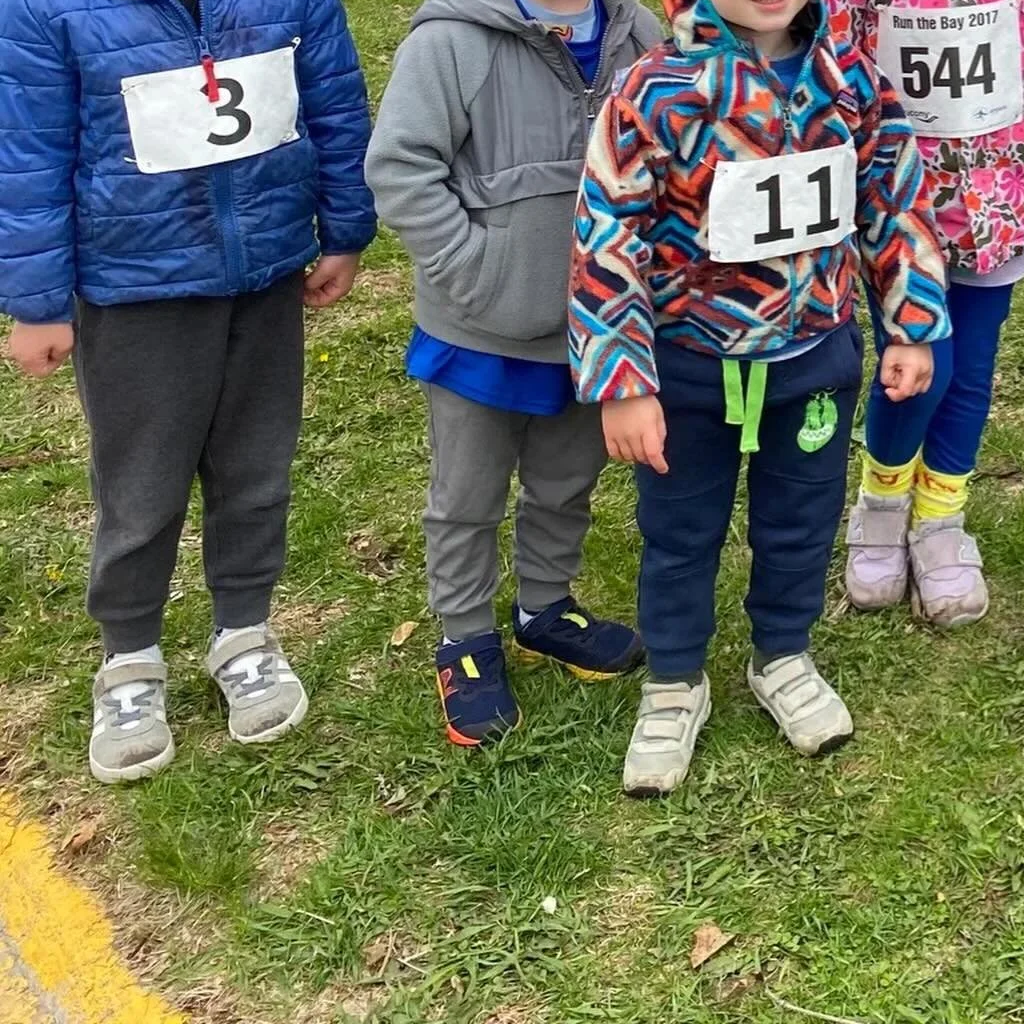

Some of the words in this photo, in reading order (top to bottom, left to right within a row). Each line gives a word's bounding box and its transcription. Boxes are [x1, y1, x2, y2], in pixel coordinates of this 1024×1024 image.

[893, 15, 914, 29] Run
[917, 17, 937, 30] the
[941, 16, 965, 31] Bay
[969, 9, 999, 27] 2017
[900, 43, 996, 99] 544
[200, 78, 252, 146] 3
[754, 165, 840, 245] 11
